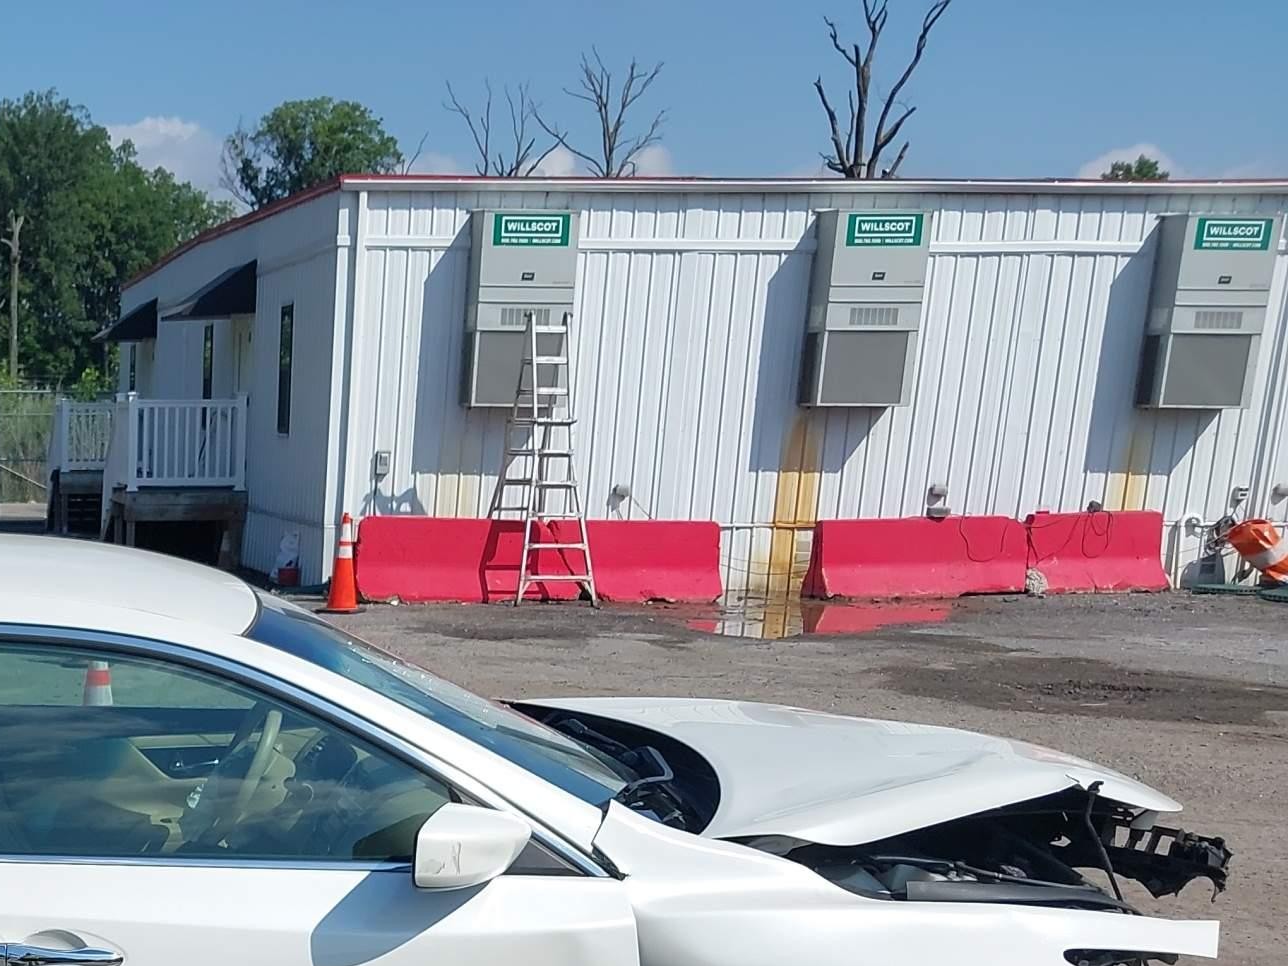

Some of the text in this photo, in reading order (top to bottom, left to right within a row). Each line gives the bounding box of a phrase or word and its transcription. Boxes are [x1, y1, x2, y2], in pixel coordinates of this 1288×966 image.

[506, 221, 558, 232] WILLSCOT
[860, 221, 911, 232] WILLSCOT
[1209, 226, 1260, 236] WILLSCOT
